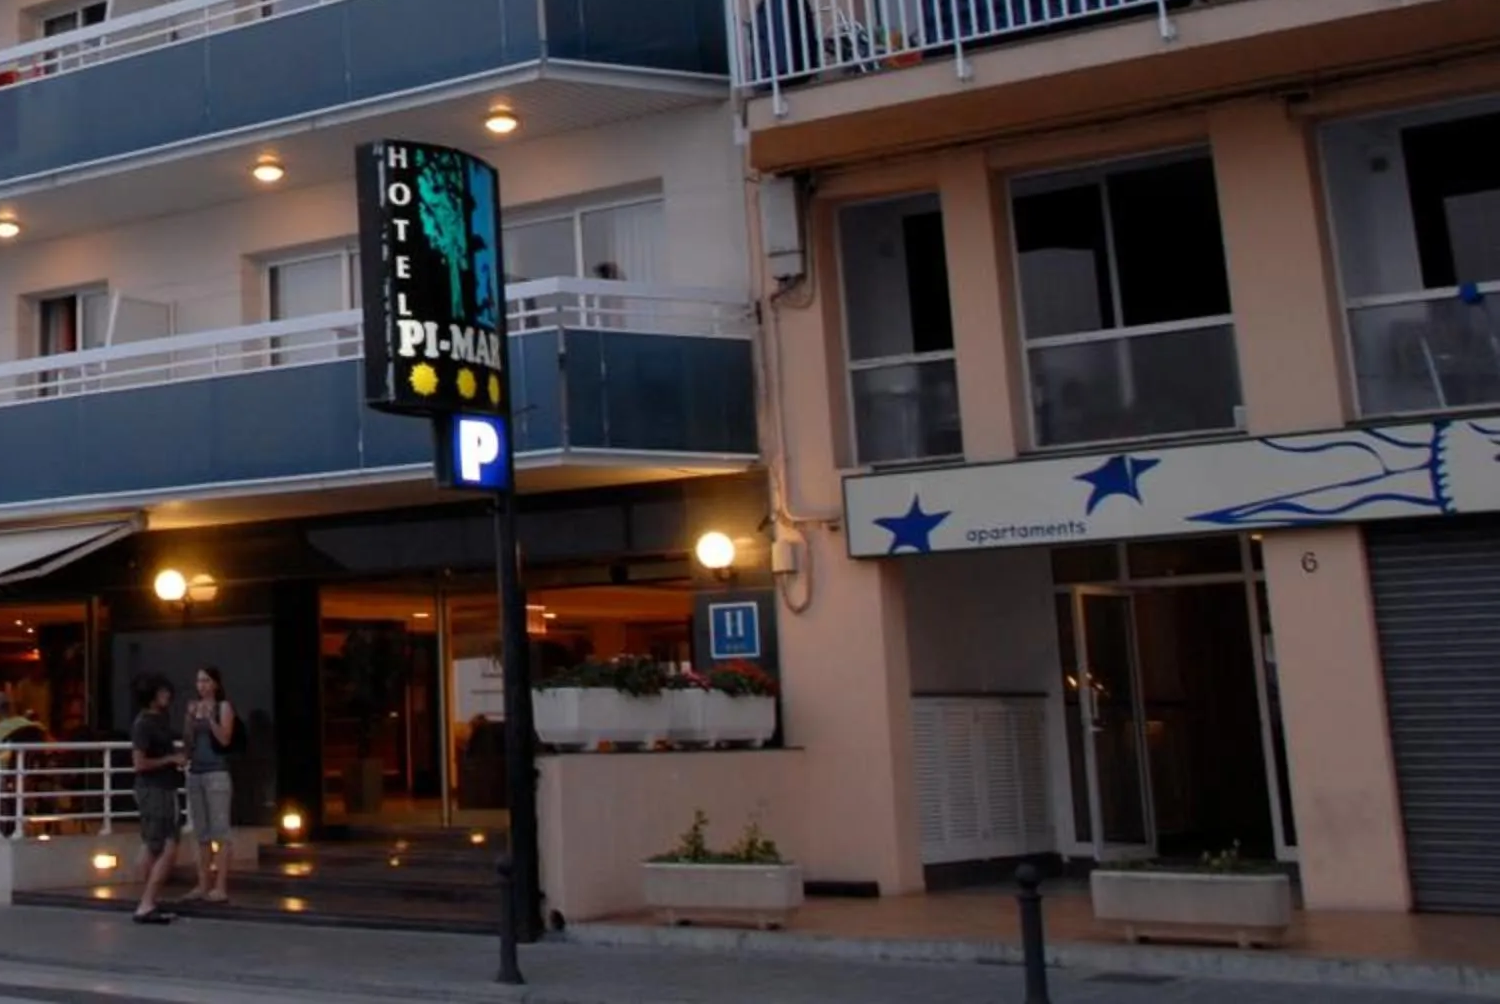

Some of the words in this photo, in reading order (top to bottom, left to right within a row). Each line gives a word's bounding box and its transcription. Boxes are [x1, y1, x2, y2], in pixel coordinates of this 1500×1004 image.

[389, 147, 411, 316] HOTEL
[397, 319, 501, 369] PI-MAR
[459, 420, 499, 481] P
[966, 521, 1087, 543] apartaments
[1301, 551, 1317, 573] 6
